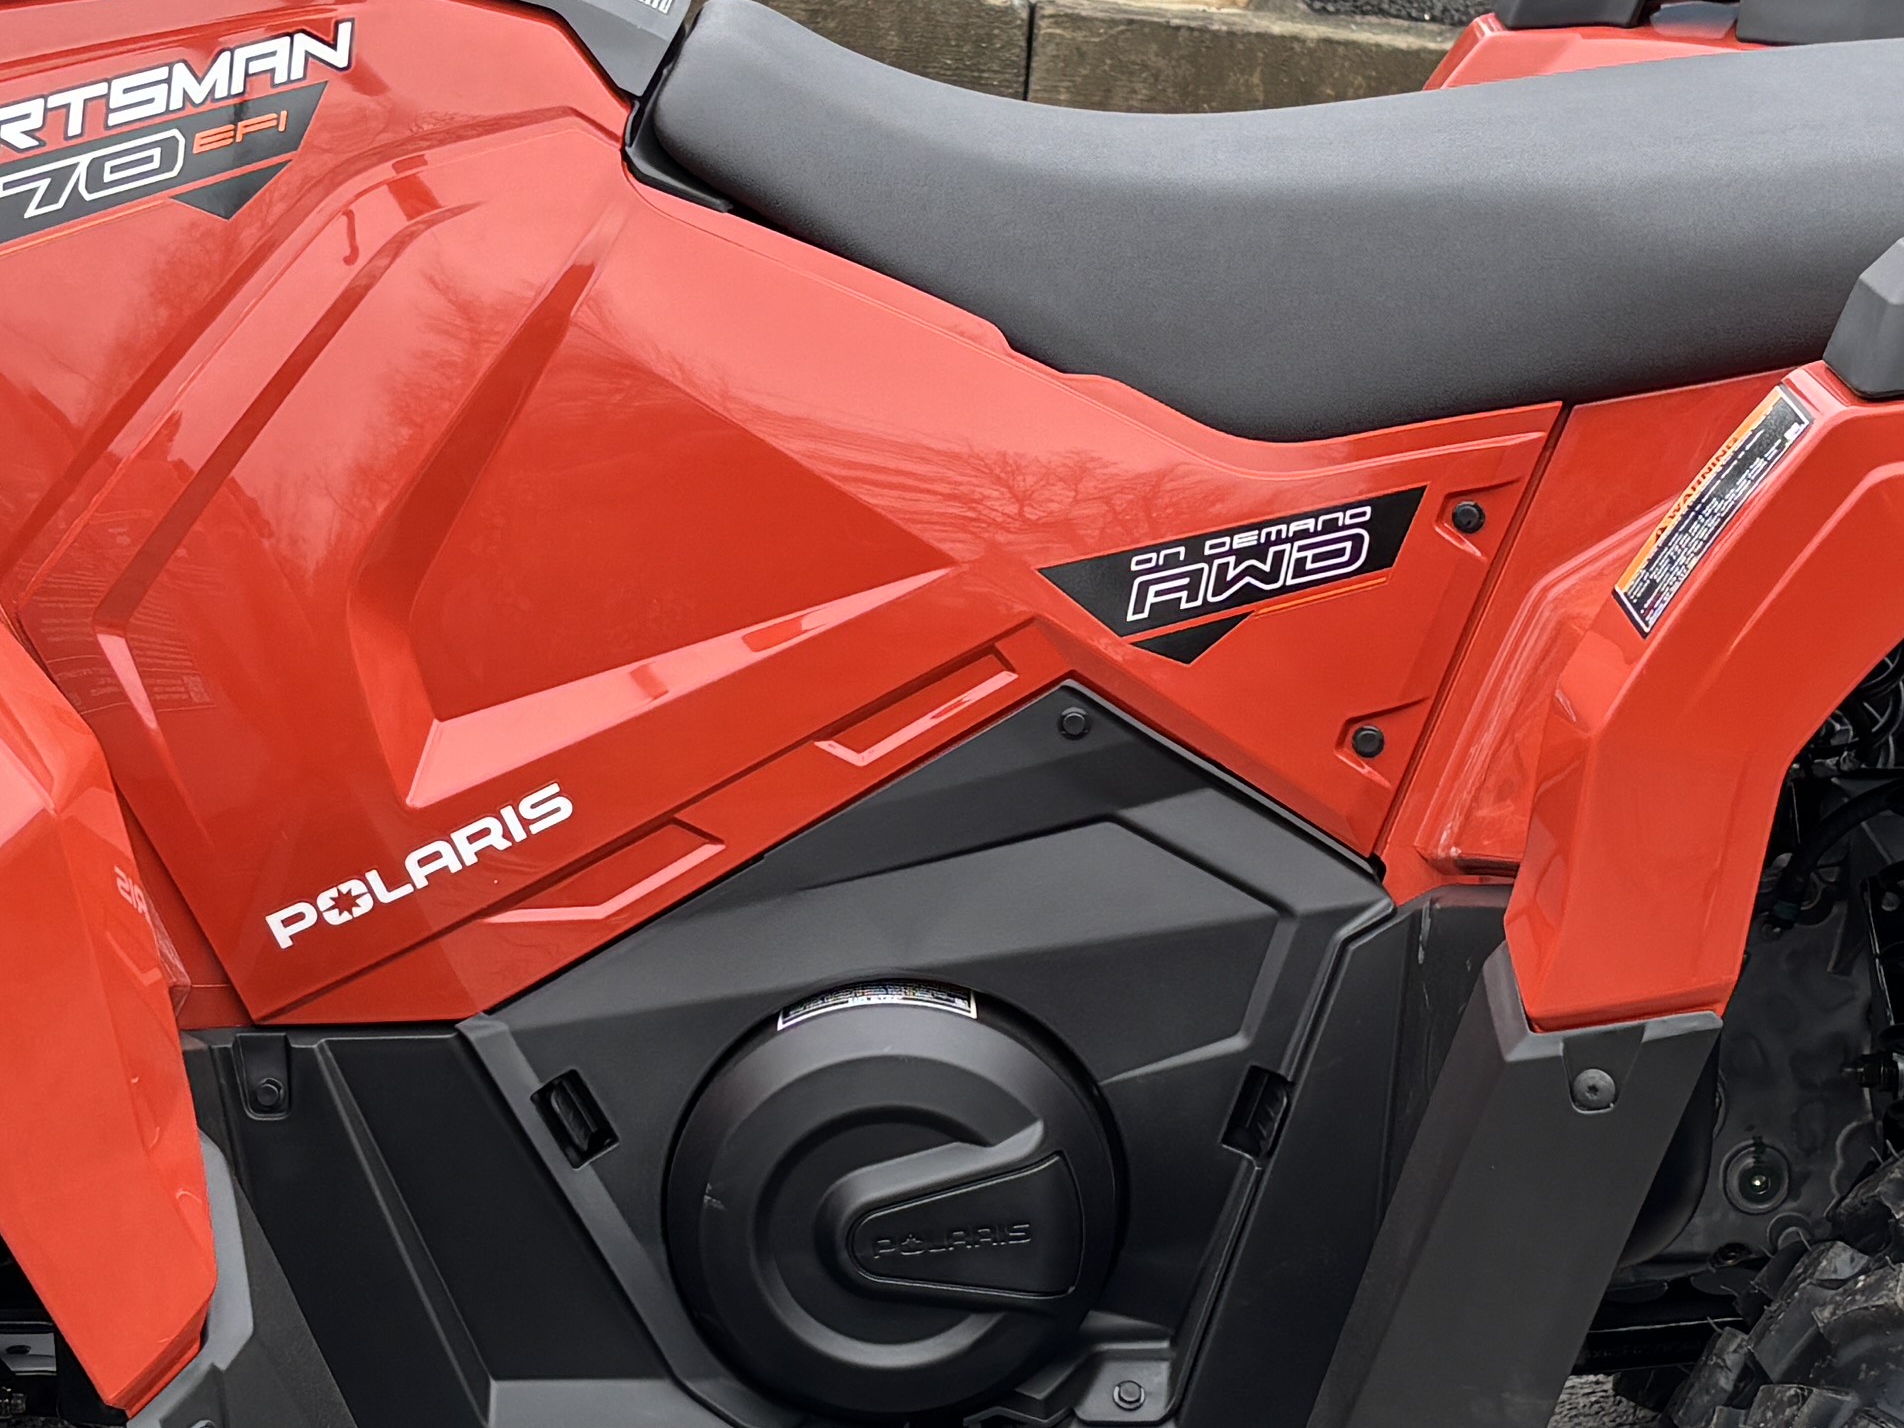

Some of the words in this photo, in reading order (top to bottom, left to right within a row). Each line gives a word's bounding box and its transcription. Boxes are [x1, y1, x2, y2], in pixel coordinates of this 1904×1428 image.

[192, 110, 289, 155] EFI
[1204, 506, 1372, 553] DEMAND
[1126, 528, 1370, 622] AWD
[265, 782, 574, 950] POLARIS
[872, 1223, 1032, 1260] POLARIS
